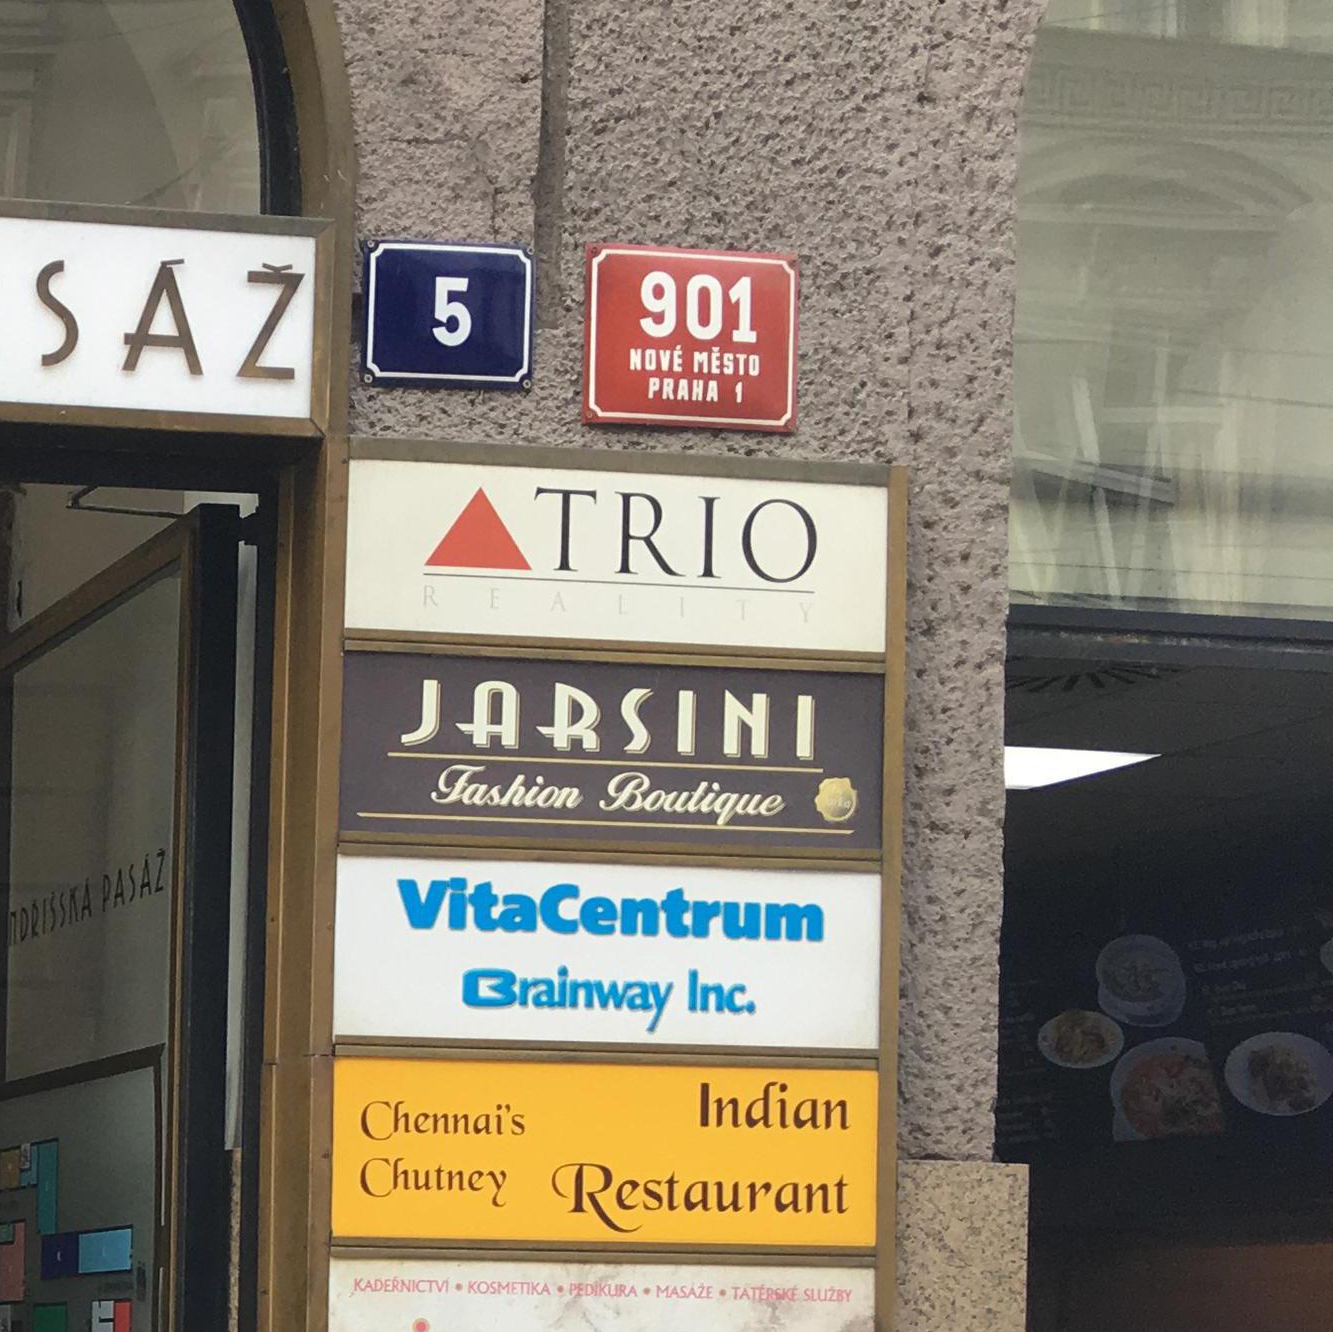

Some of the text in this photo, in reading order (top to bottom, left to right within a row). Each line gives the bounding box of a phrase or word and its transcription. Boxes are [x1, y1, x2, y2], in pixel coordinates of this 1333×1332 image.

[432, 276, 472, 347] 5
[640, 270, 757, 343] 901
[629, 345, 760, 377] NOVÉ MĚSTO
[648, 377, 744, 403] PRAHA 1
[534, 486, 817, 583] TRIO
[401, 679, 816, 760] JARSINI
[430, 764, 787, 827] Fashion Boutique
[397, 876, 824, 942] VitaCentrum
[462, 965, 756, 1033] Brainway Inc.
[360, 1101, 526, 1141] Chennai's
[699, 1081, 850, 1131] Indian
[360, 1158, 507, 1207] Chutney
[551, 1163, 850, 1233] Restaurant
[468, 1280, 550, 1296] KOSMETIKA
[656, 1283, 713, 1300] MASÁŽE
[804, 1285, 852, 1304] SLUŽBY
